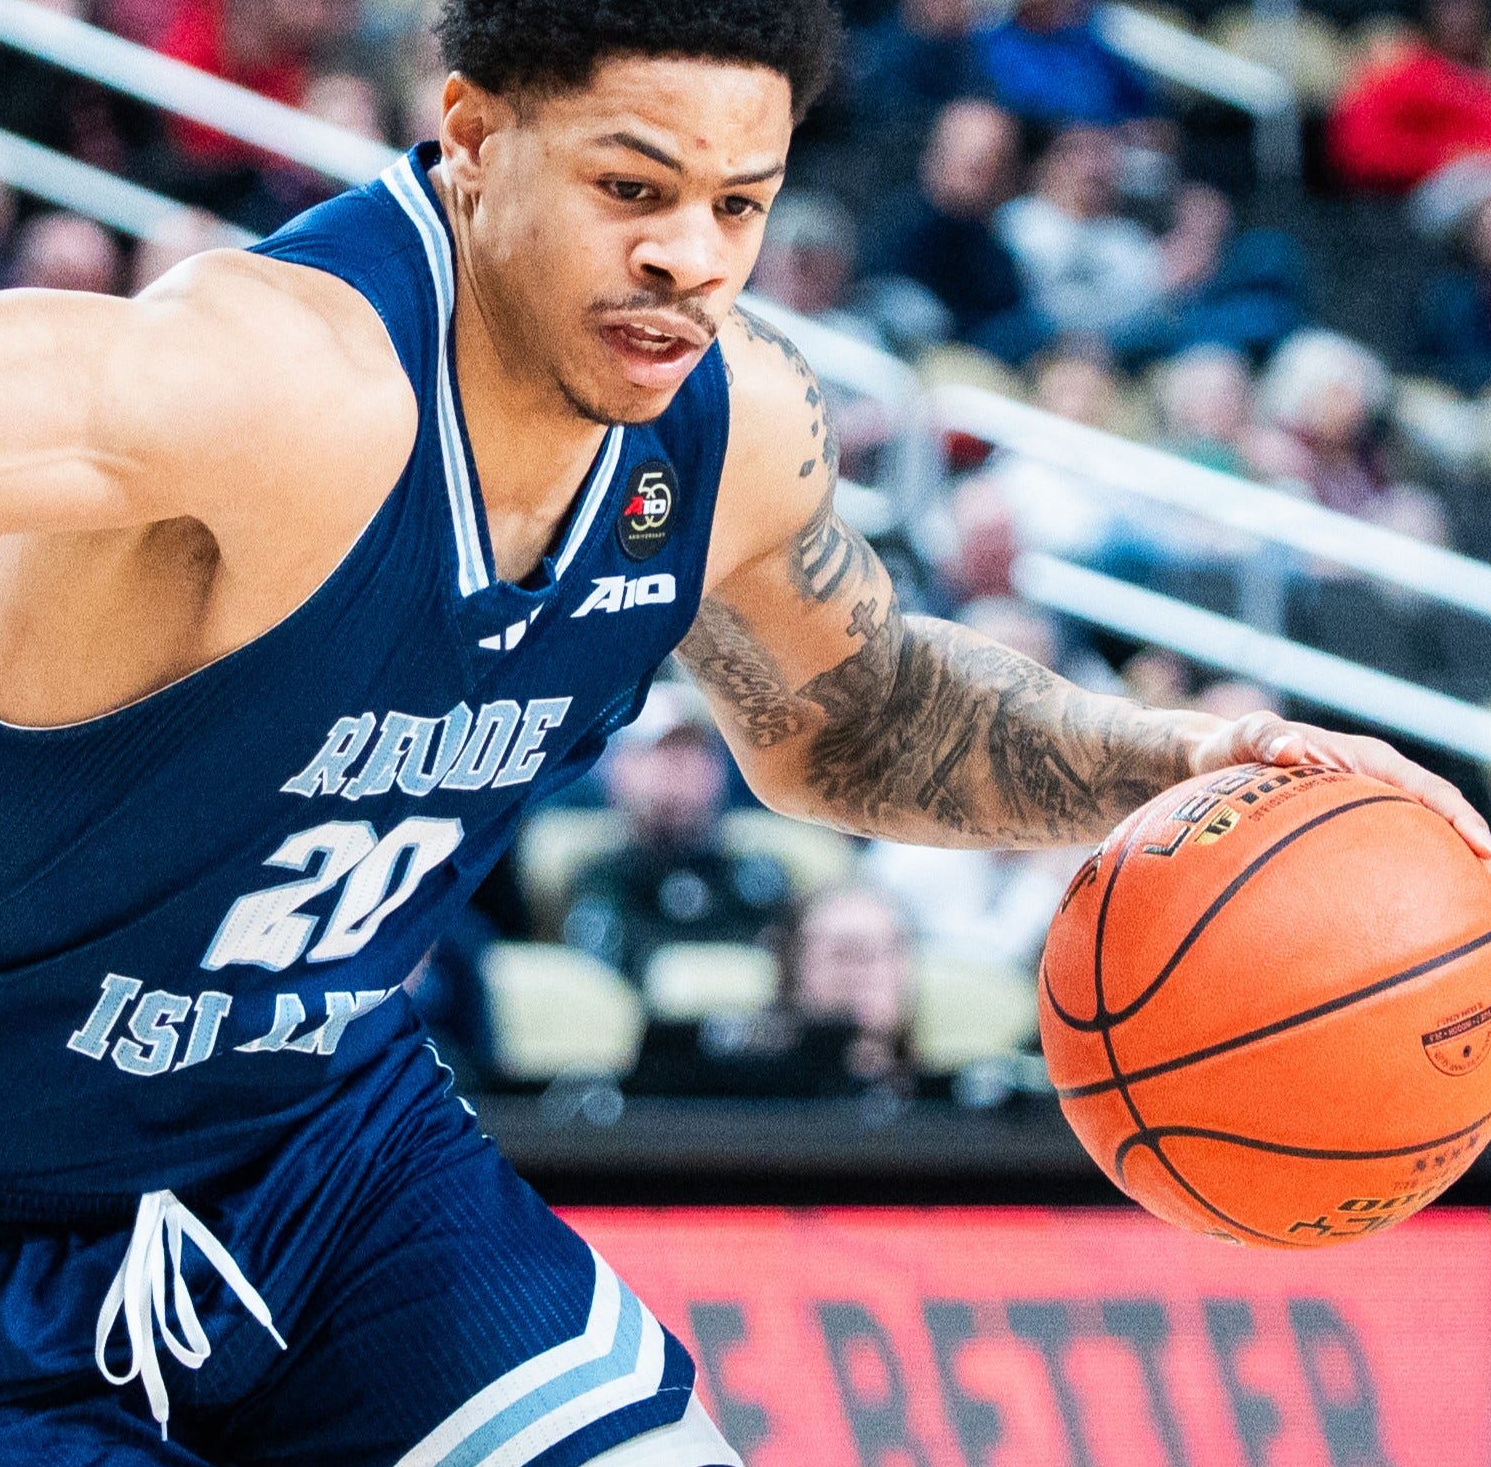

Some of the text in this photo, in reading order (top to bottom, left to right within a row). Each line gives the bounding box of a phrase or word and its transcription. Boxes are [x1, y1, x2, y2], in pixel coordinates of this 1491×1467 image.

[624, 495, 667, 516] A10
[570, 573, 676, 618] A10
[200, 817, 465, 971] 20
